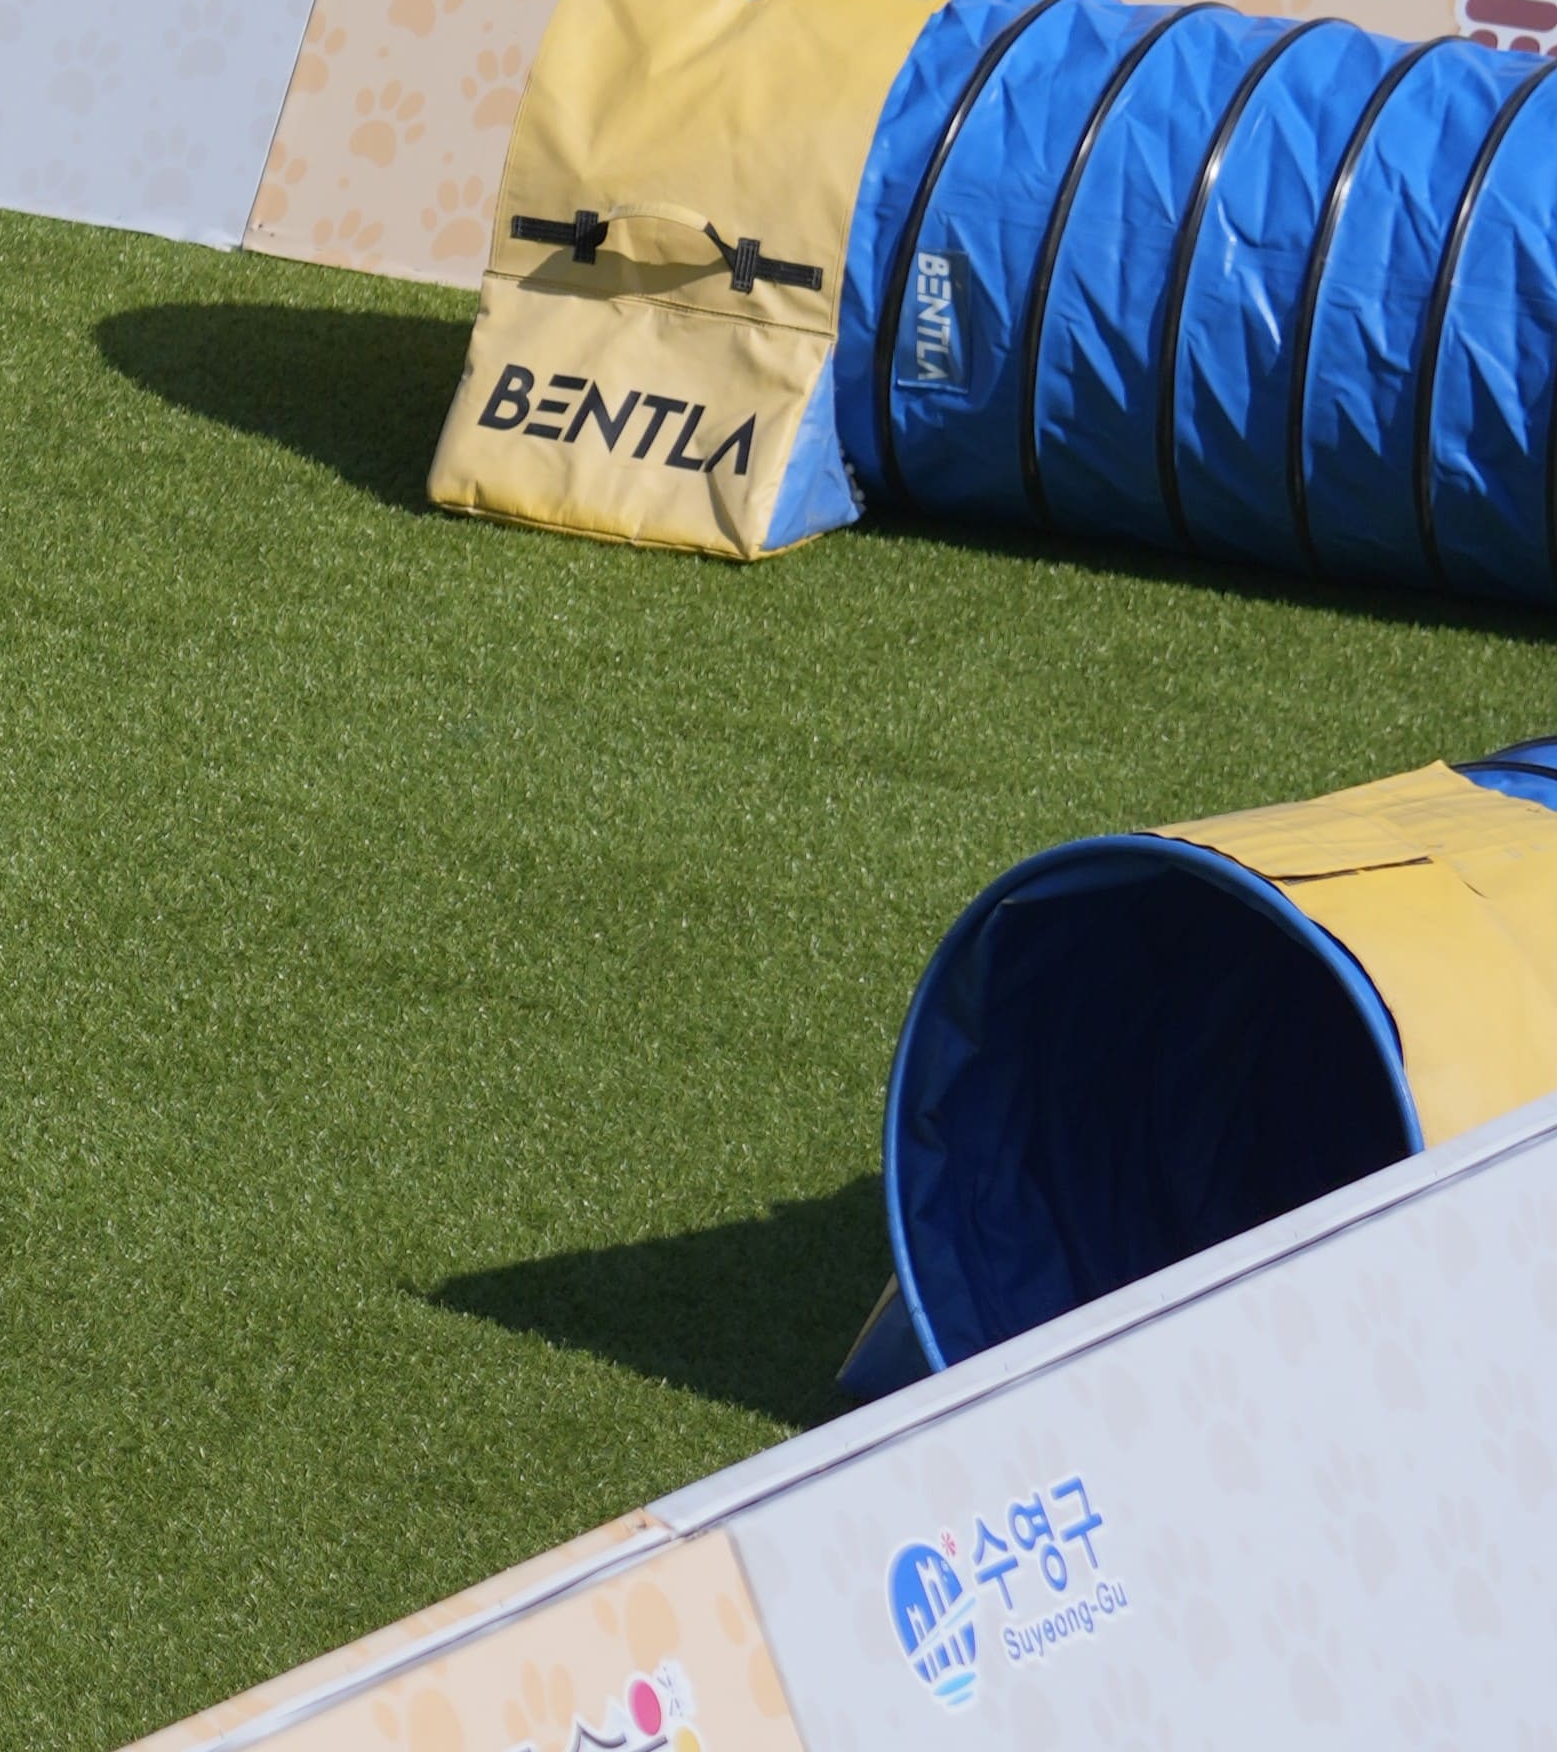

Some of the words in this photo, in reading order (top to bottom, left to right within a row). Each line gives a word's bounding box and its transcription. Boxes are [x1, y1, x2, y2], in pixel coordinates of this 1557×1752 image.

[918, 251, 952, 382] BENTLA
[477, 363, 757, 476] BENTLA
[972, 1476, 1104, 1609] 수영구
[1002, 1578, 1129, 1661] Suyeong-Gu
